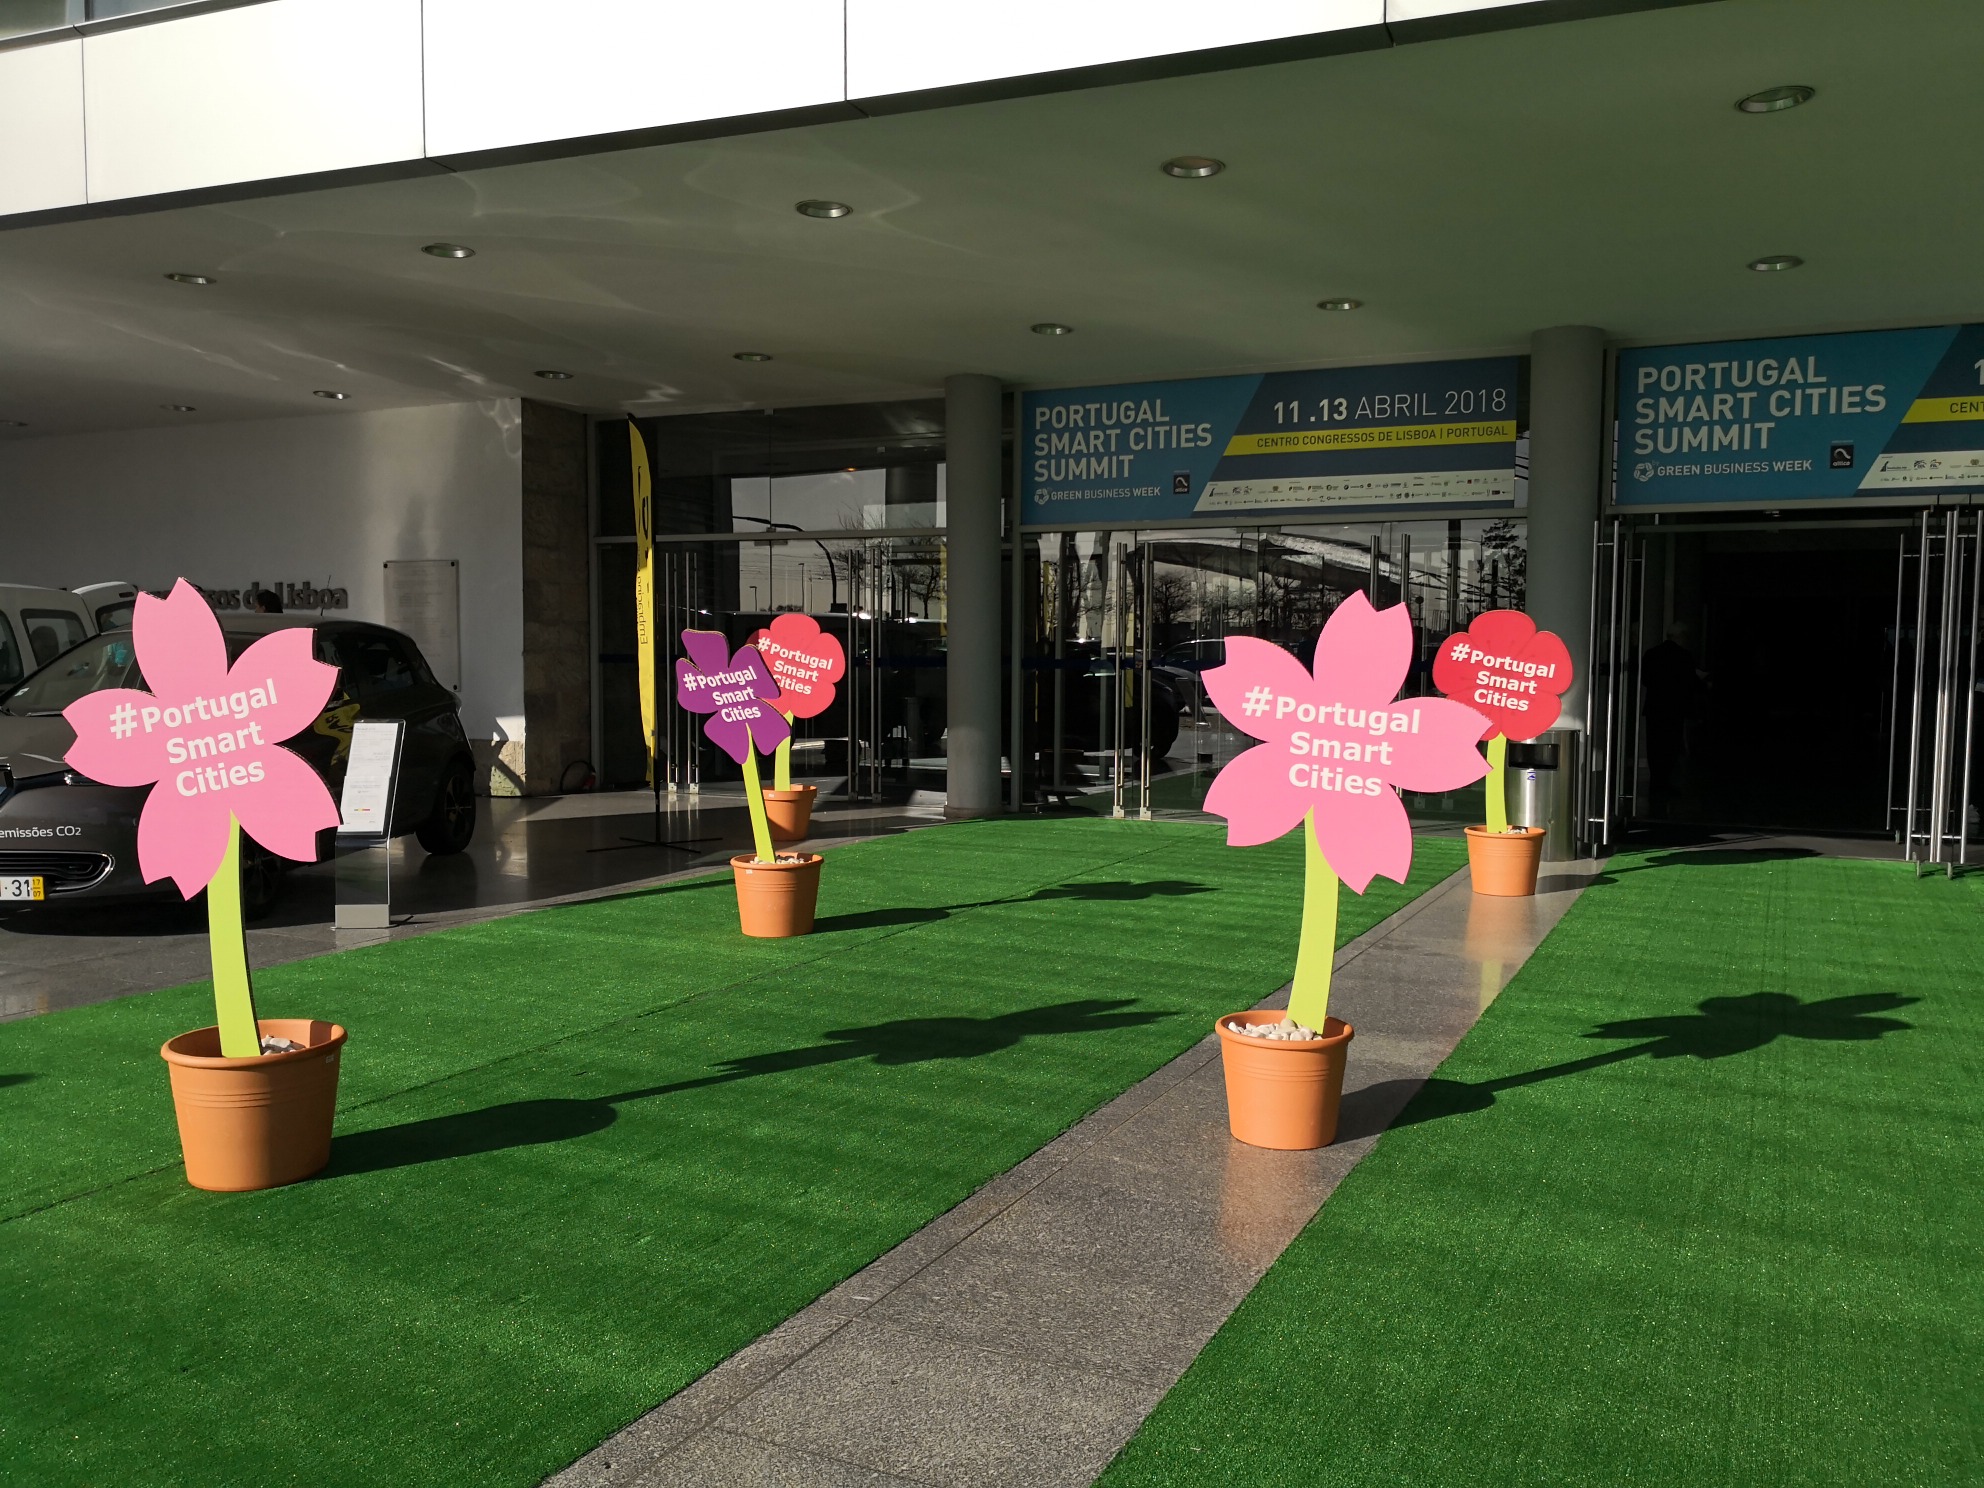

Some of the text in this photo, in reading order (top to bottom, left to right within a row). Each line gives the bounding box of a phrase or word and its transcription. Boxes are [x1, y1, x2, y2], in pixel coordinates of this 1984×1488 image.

[1638, 356, 1827, 394] PORTUGAL
[1035, 399, 1169, 429] PORTUGAL
[1354, 393, 1437, 419] ABRIL
[1444, 388, 1506, 415] 2018
[1634, 384, 1887, 425] SMART CITIES
[1034, 423, 1212, 456] SMART CITIES
[1257, 435, 1299, 448] CENTRO
[1302, 431, 1375, 446] CONGRESSOS
[1378, 431, 1393, 441] DE
[1396, 429, 1436, 440] LISBOA
[1446, 425, 1509, 438] PORTUGAL
[1633, 422, 1775, 455] SUMMIT
[1034, 454, 1134, 482] SUMMIT
[1657, 459, 1812, 477] GREEN BUSINESS WEEK
[1051, 486, 1161, 501] GREEN BUSINESS WEEK
[274, 581, 348, 610] Lisboa
[756, 636, 833, 670] #Portugal
[1450, 642, 1555, 679] #Portugal
[683, 666, 757, 691] #Portugal
[773, 660, 819, 682] Smart
[1475, 670, 1537, 695] Smart
[109, 678, 278, 740] #Portugal
[712, 686, 756, 706] Smart
[1241, 685, 1421, 736] #Portugal
[1473, 689, 1530, 712] Cities
[721, 706, 761, 723] Cities
[166, 721, 265, 764] Smart
[1289, 731, 1393, 766] Smart
[176, 761, 265, 797] Cities
[1288, 763, 1382, 797] Cities
[0, 827, 53, 838] emissões
